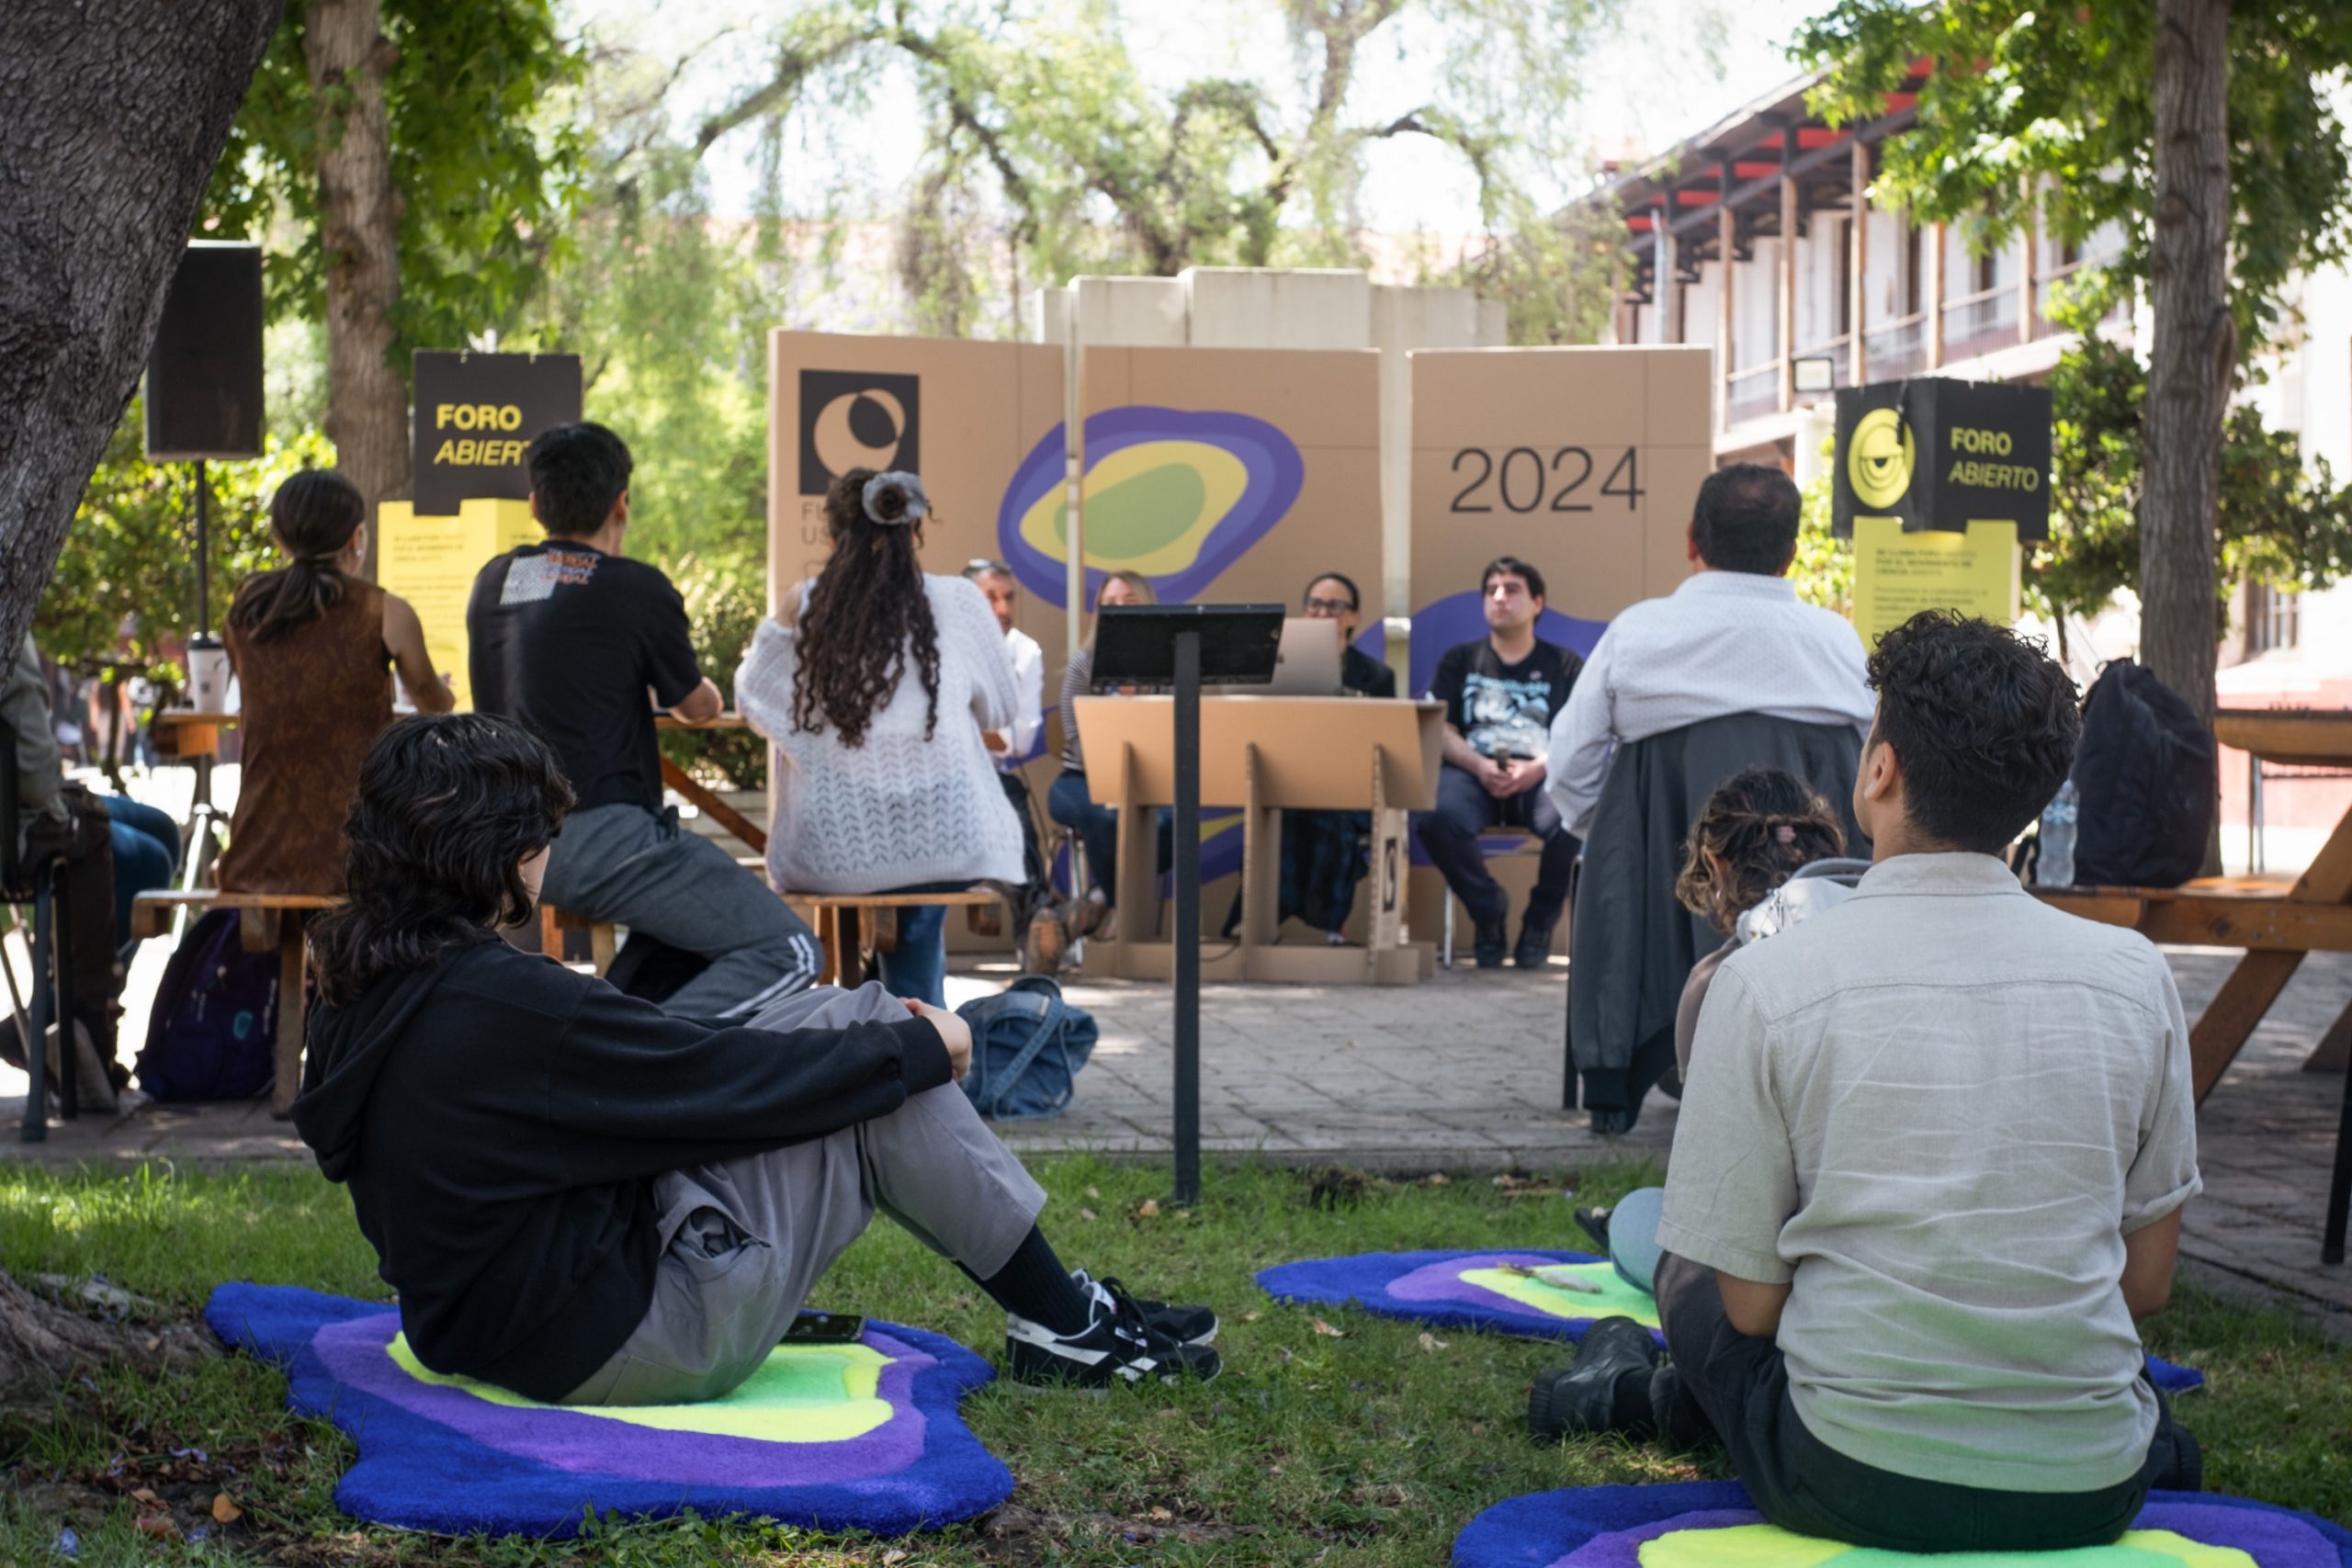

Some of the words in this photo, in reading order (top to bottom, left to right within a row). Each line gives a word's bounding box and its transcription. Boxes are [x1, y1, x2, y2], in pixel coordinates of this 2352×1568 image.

[436, 403, 523, 432] FORO
[433, 438, 532, 467] ABIER
[1951, 426, 2013, 457] FORO
[1449, 446, 1646, 513] 2024
[1948, 459, 2040, 493] ABIERTO
